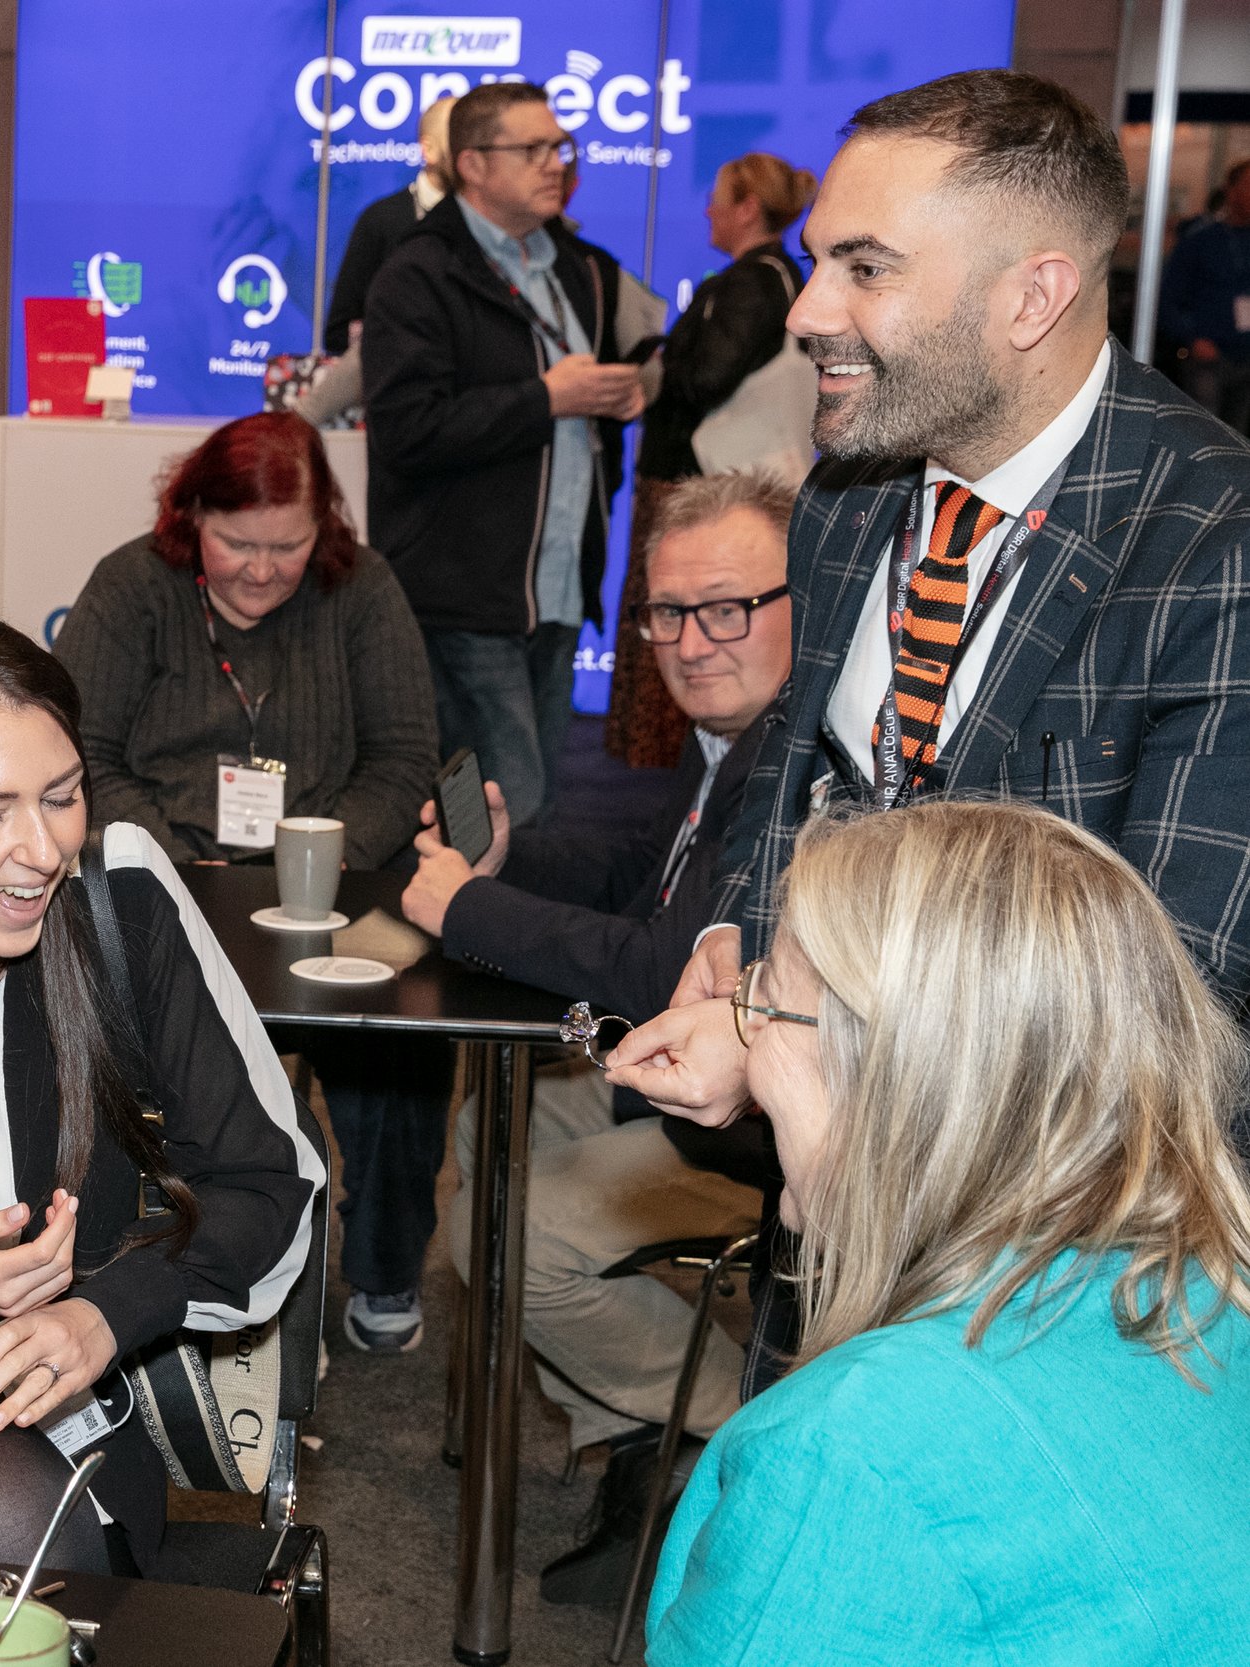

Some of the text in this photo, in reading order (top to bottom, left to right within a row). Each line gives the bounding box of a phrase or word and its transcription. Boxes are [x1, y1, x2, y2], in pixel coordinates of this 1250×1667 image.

[295, 56, 691, 134] Conect
[310, 139, 424, 166] Technolog
[586, 141, 672, 167] Service
[231, 340, 270, 358] 24/7
[209, 357, 267, 377] Monitor
[896, 489, 919, 612] GBR Digital Health Solutions
[1013, 526, 1030, 547] GBR
[995, 544, 1018, 575] Digital
[883, 707, 897, 784] ANALOGUE
[235, 1330, 253, 1374] ior
